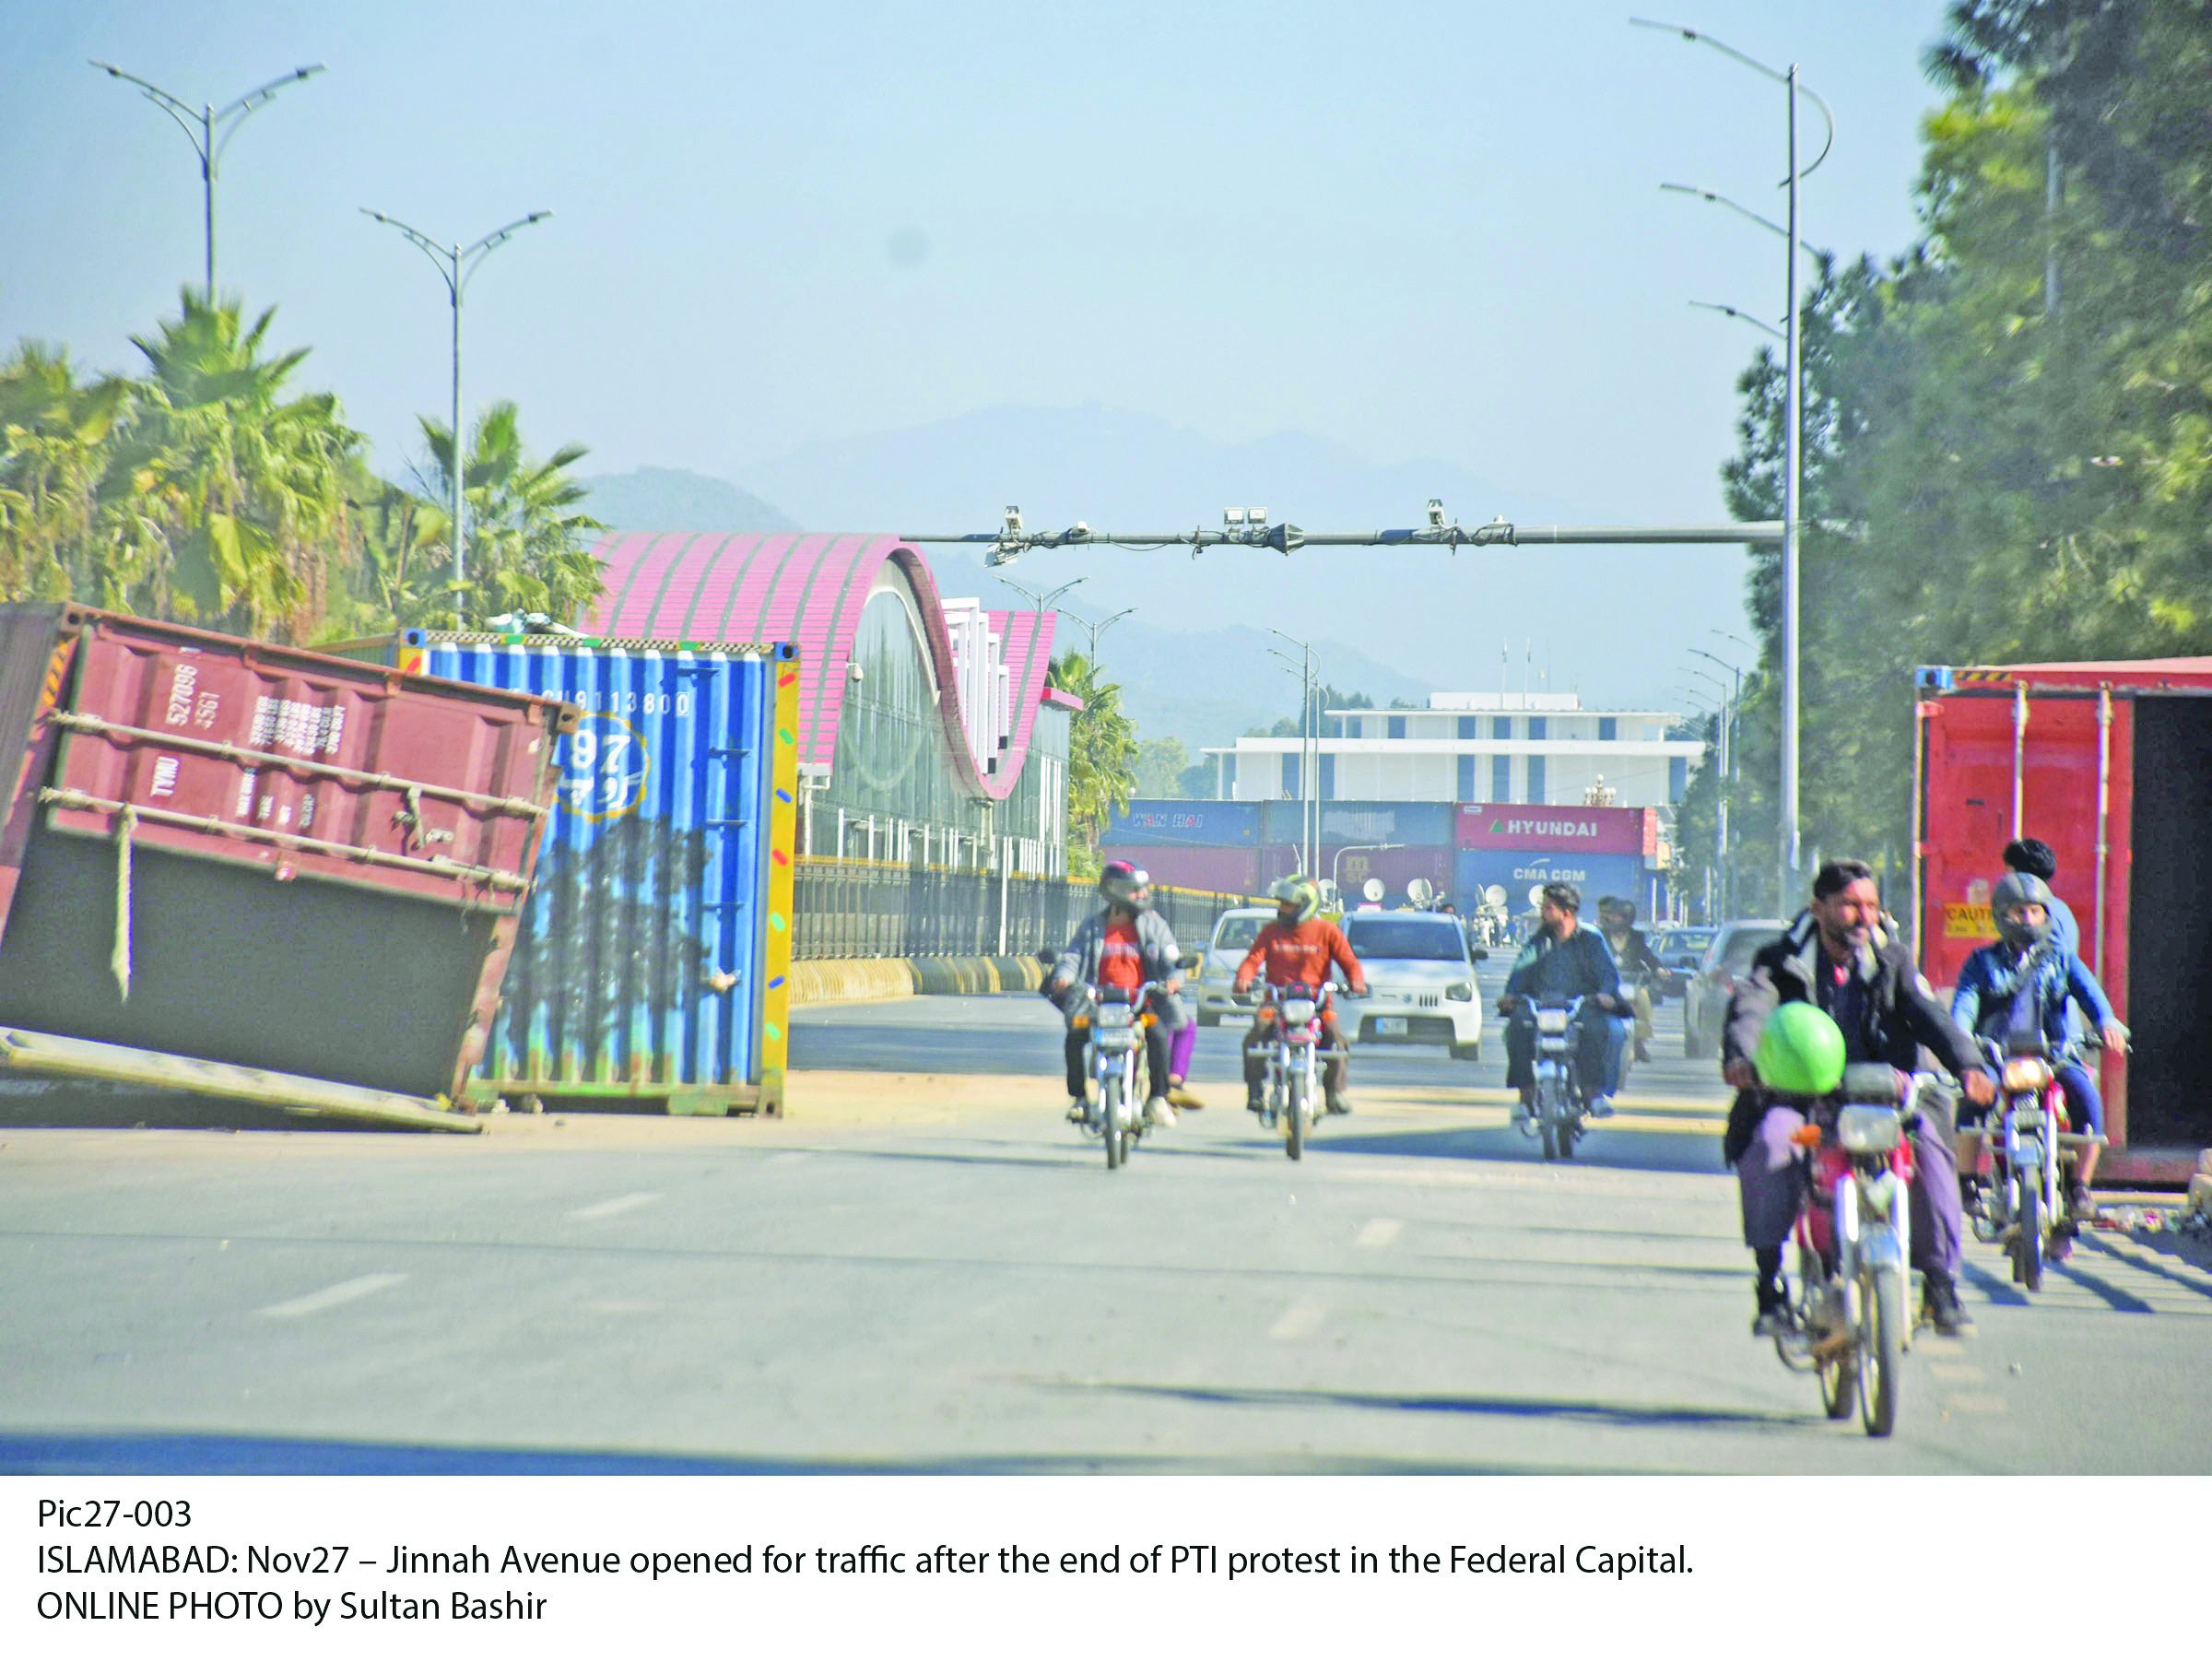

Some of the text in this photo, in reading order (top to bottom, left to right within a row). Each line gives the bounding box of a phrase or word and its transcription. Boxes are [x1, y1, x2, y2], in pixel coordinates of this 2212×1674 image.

[165, 663, 198, 726] 527096
[1507, 819, 1598, 837] HYUNDAI
[1512, 867, 1586, 881] CMA CGM
